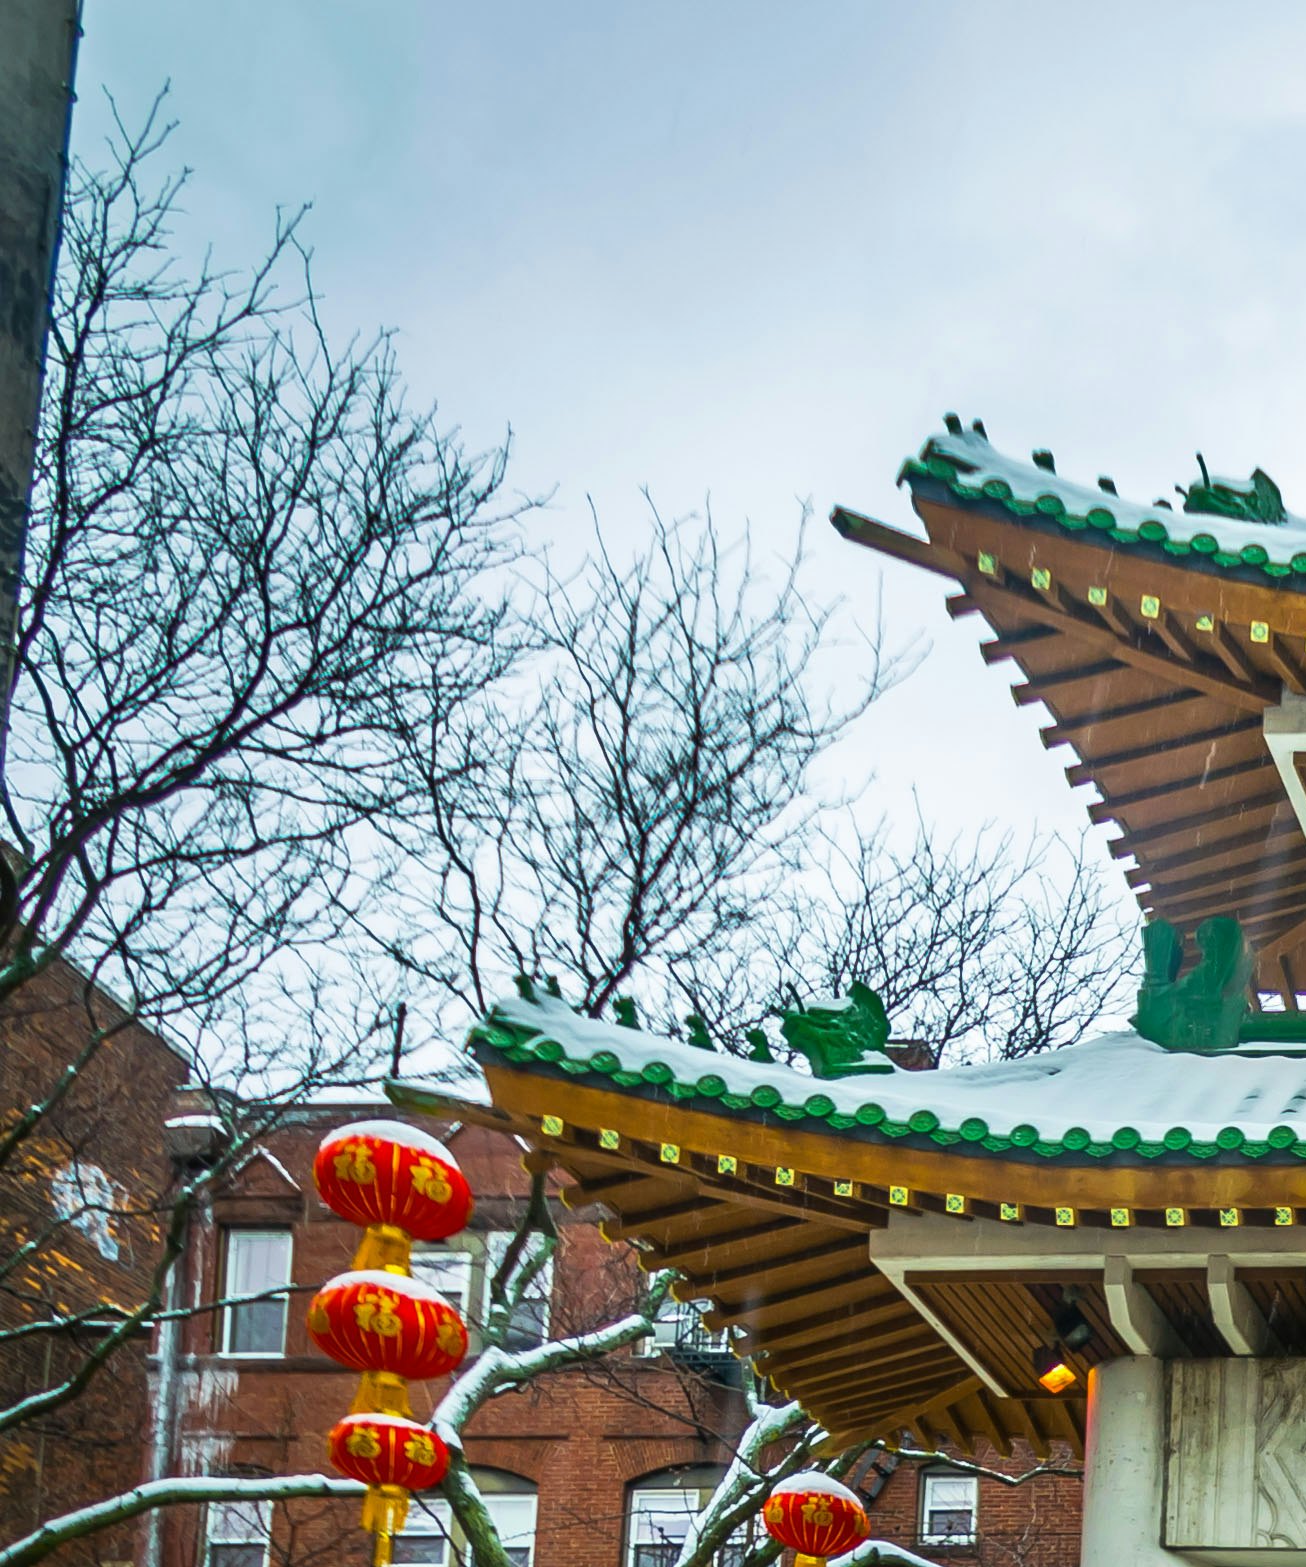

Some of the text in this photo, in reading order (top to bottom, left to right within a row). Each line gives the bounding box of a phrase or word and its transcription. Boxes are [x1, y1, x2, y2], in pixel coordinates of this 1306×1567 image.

[333, 1143, 377, 1185] 福
[410, 1156, 453, 1204] 福
[353, 1293, 403, 1337] 福
